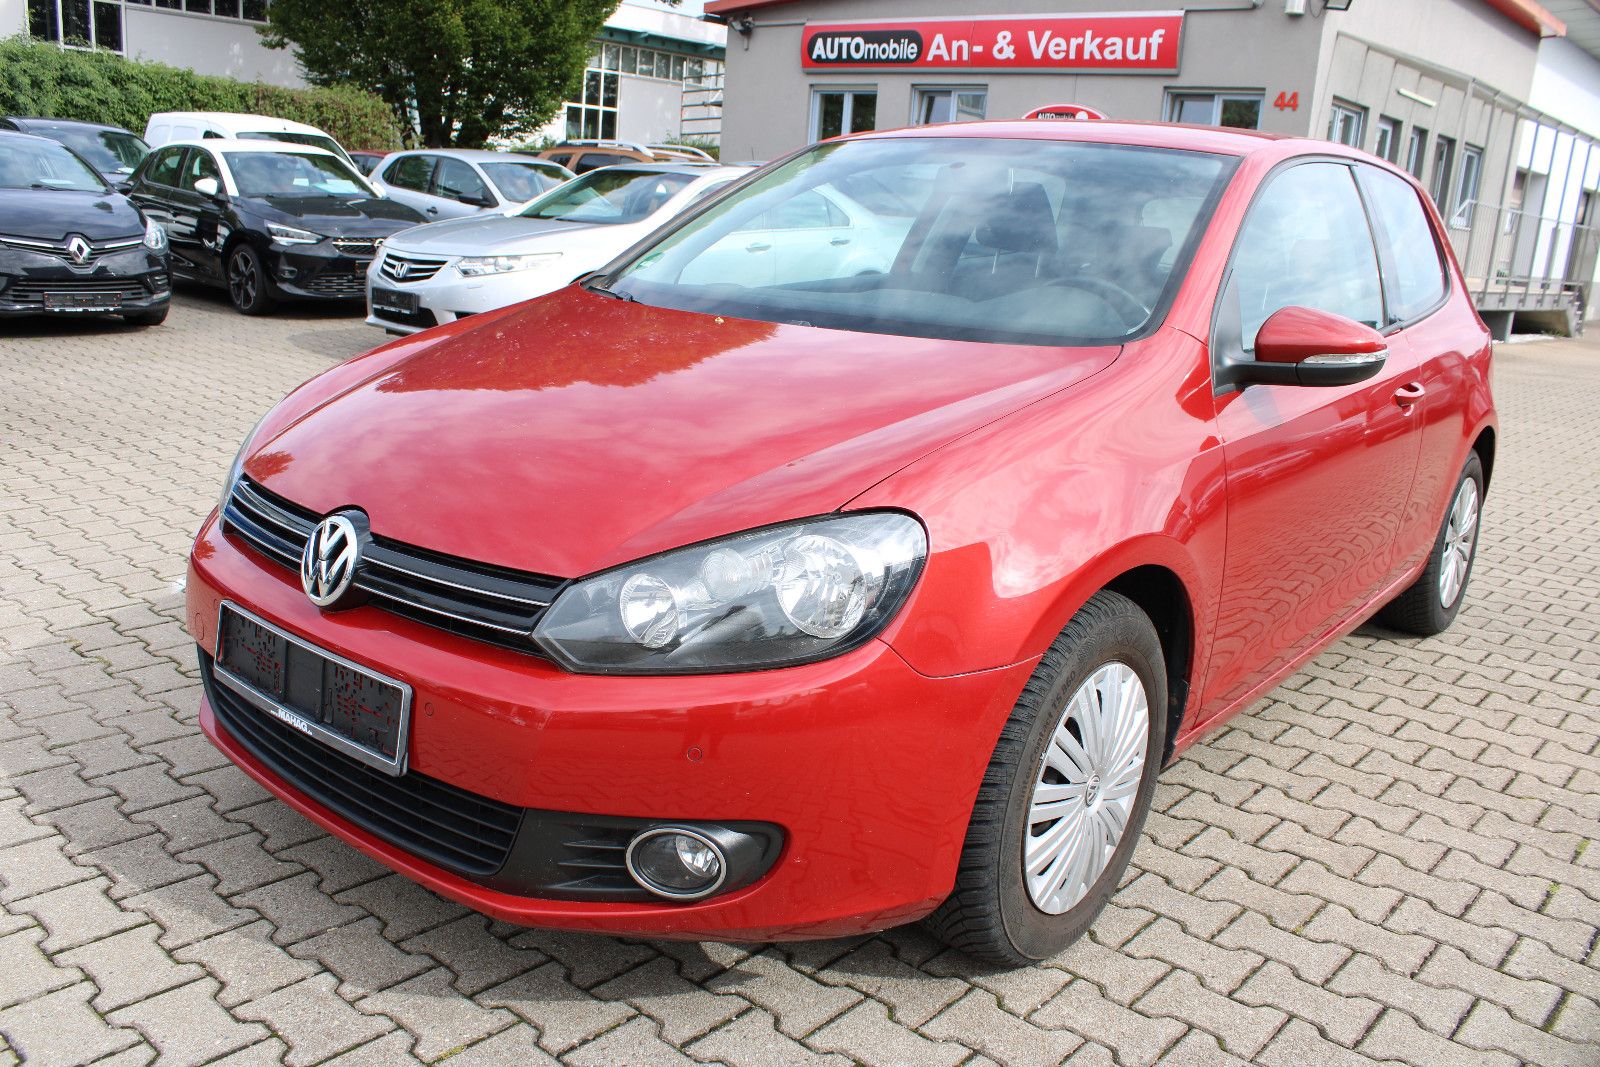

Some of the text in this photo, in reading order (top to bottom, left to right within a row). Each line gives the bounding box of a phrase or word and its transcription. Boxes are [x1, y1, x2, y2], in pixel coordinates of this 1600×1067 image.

[812, 28, 1165, 61] AUTOmobile An- & Verkauf
[1273, 91, 1298, 111] 44
